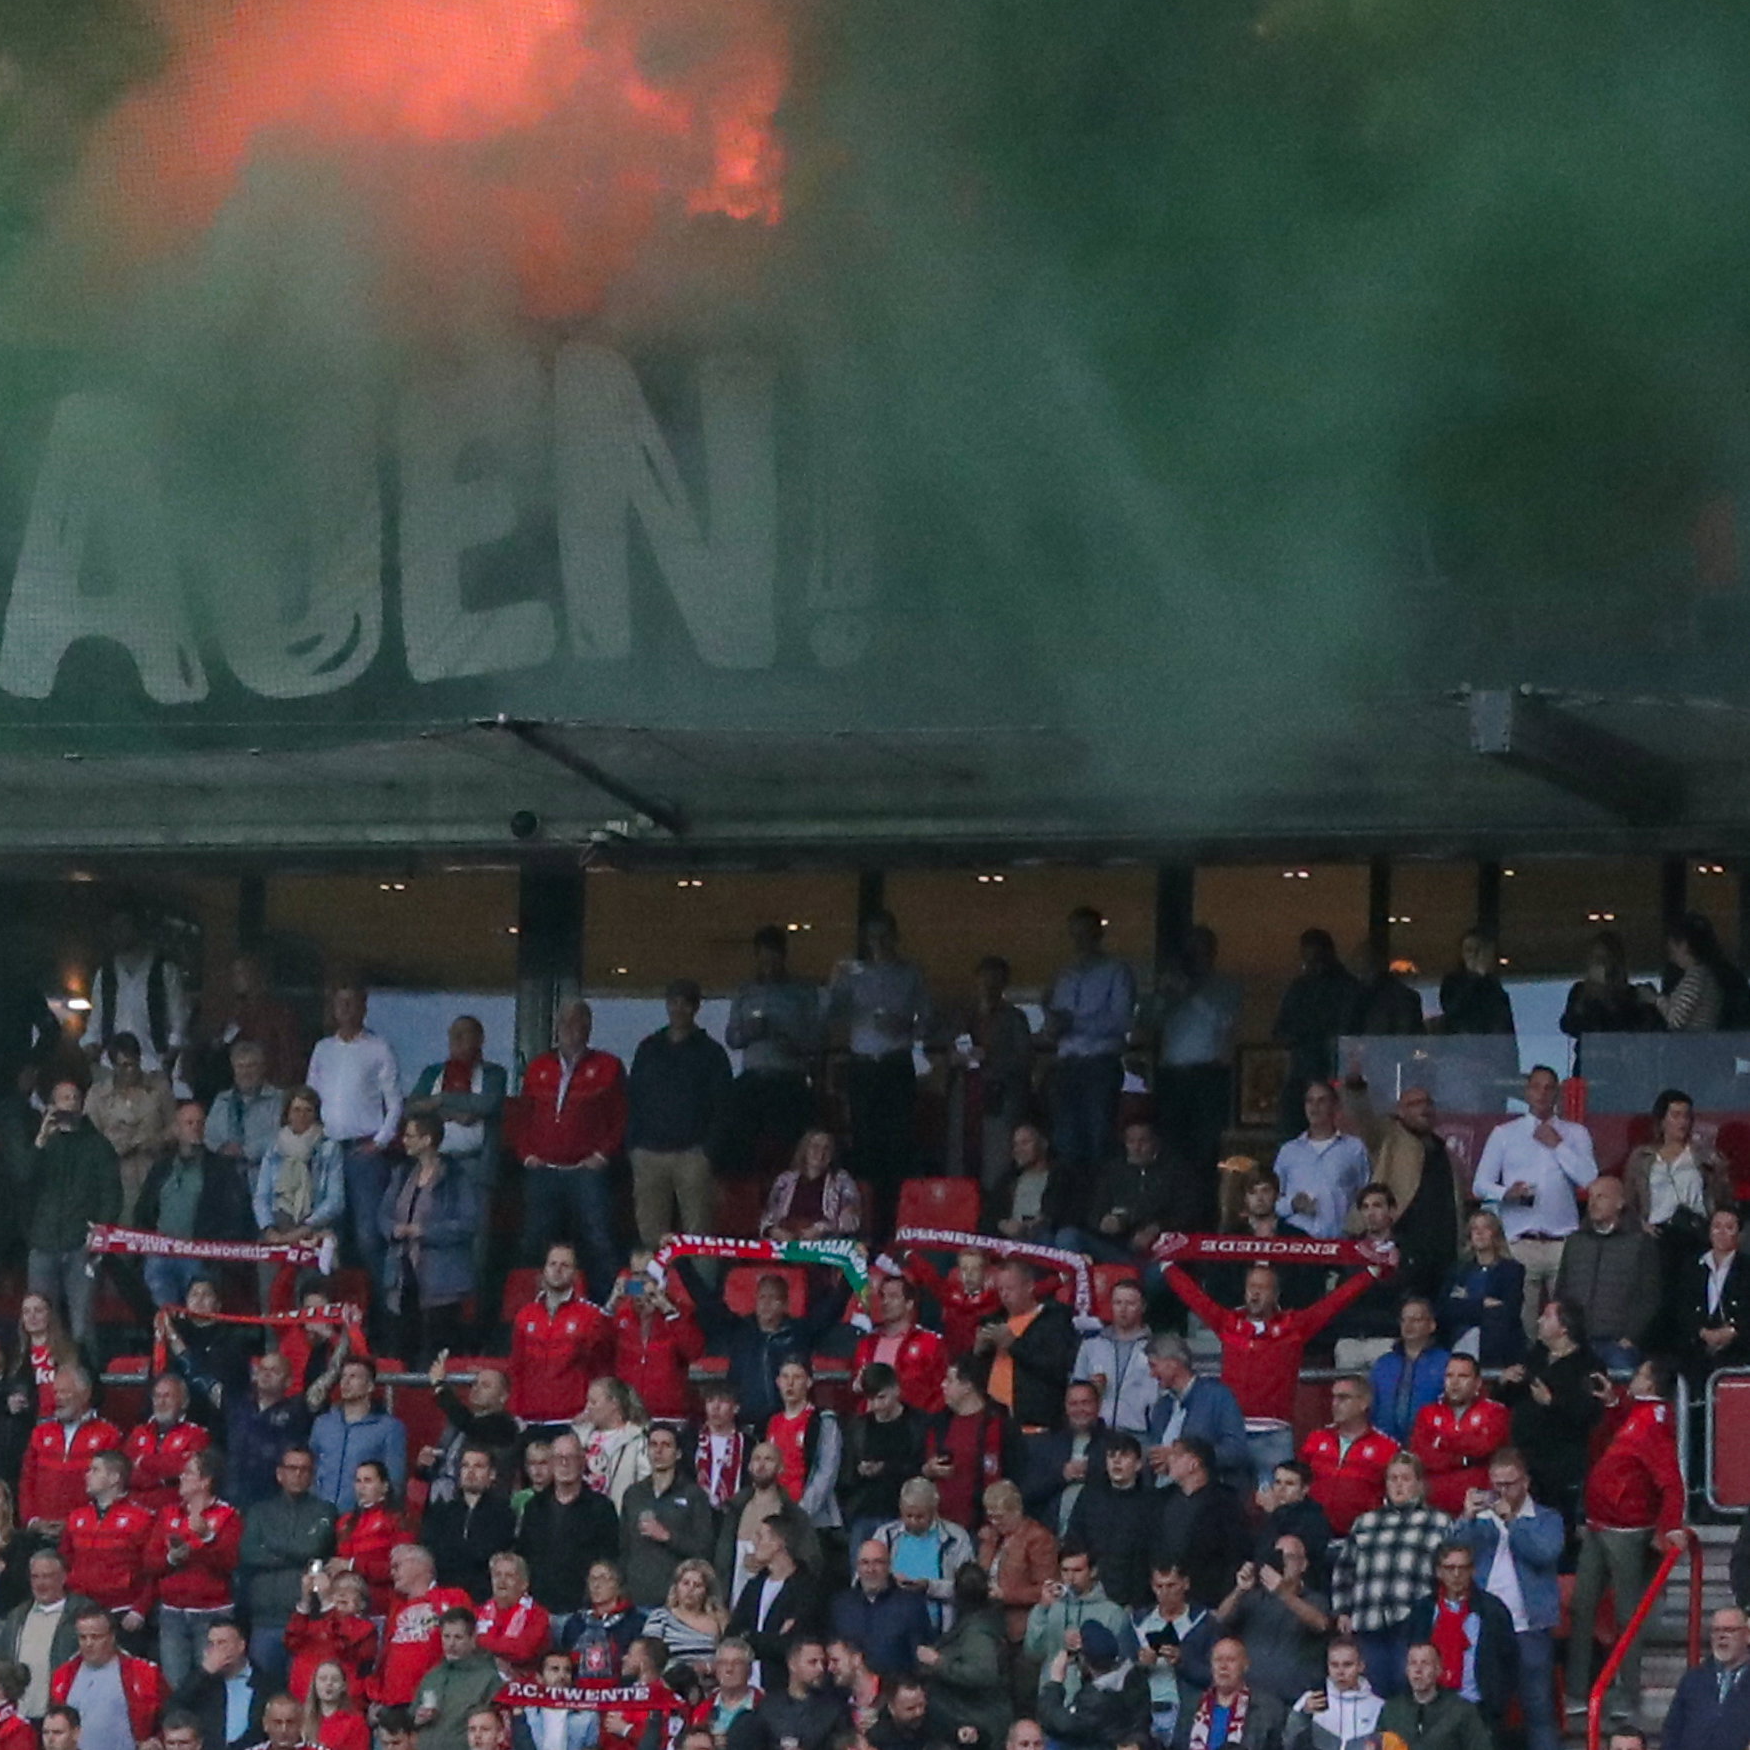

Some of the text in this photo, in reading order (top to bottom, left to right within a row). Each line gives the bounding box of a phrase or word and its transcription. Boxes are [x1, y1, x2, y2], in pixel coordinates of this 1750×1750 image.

[1201, 1239, 1340, 1255] ENSCHEDE
[508, 1683, 649, 1701] F.C. TWENTE
